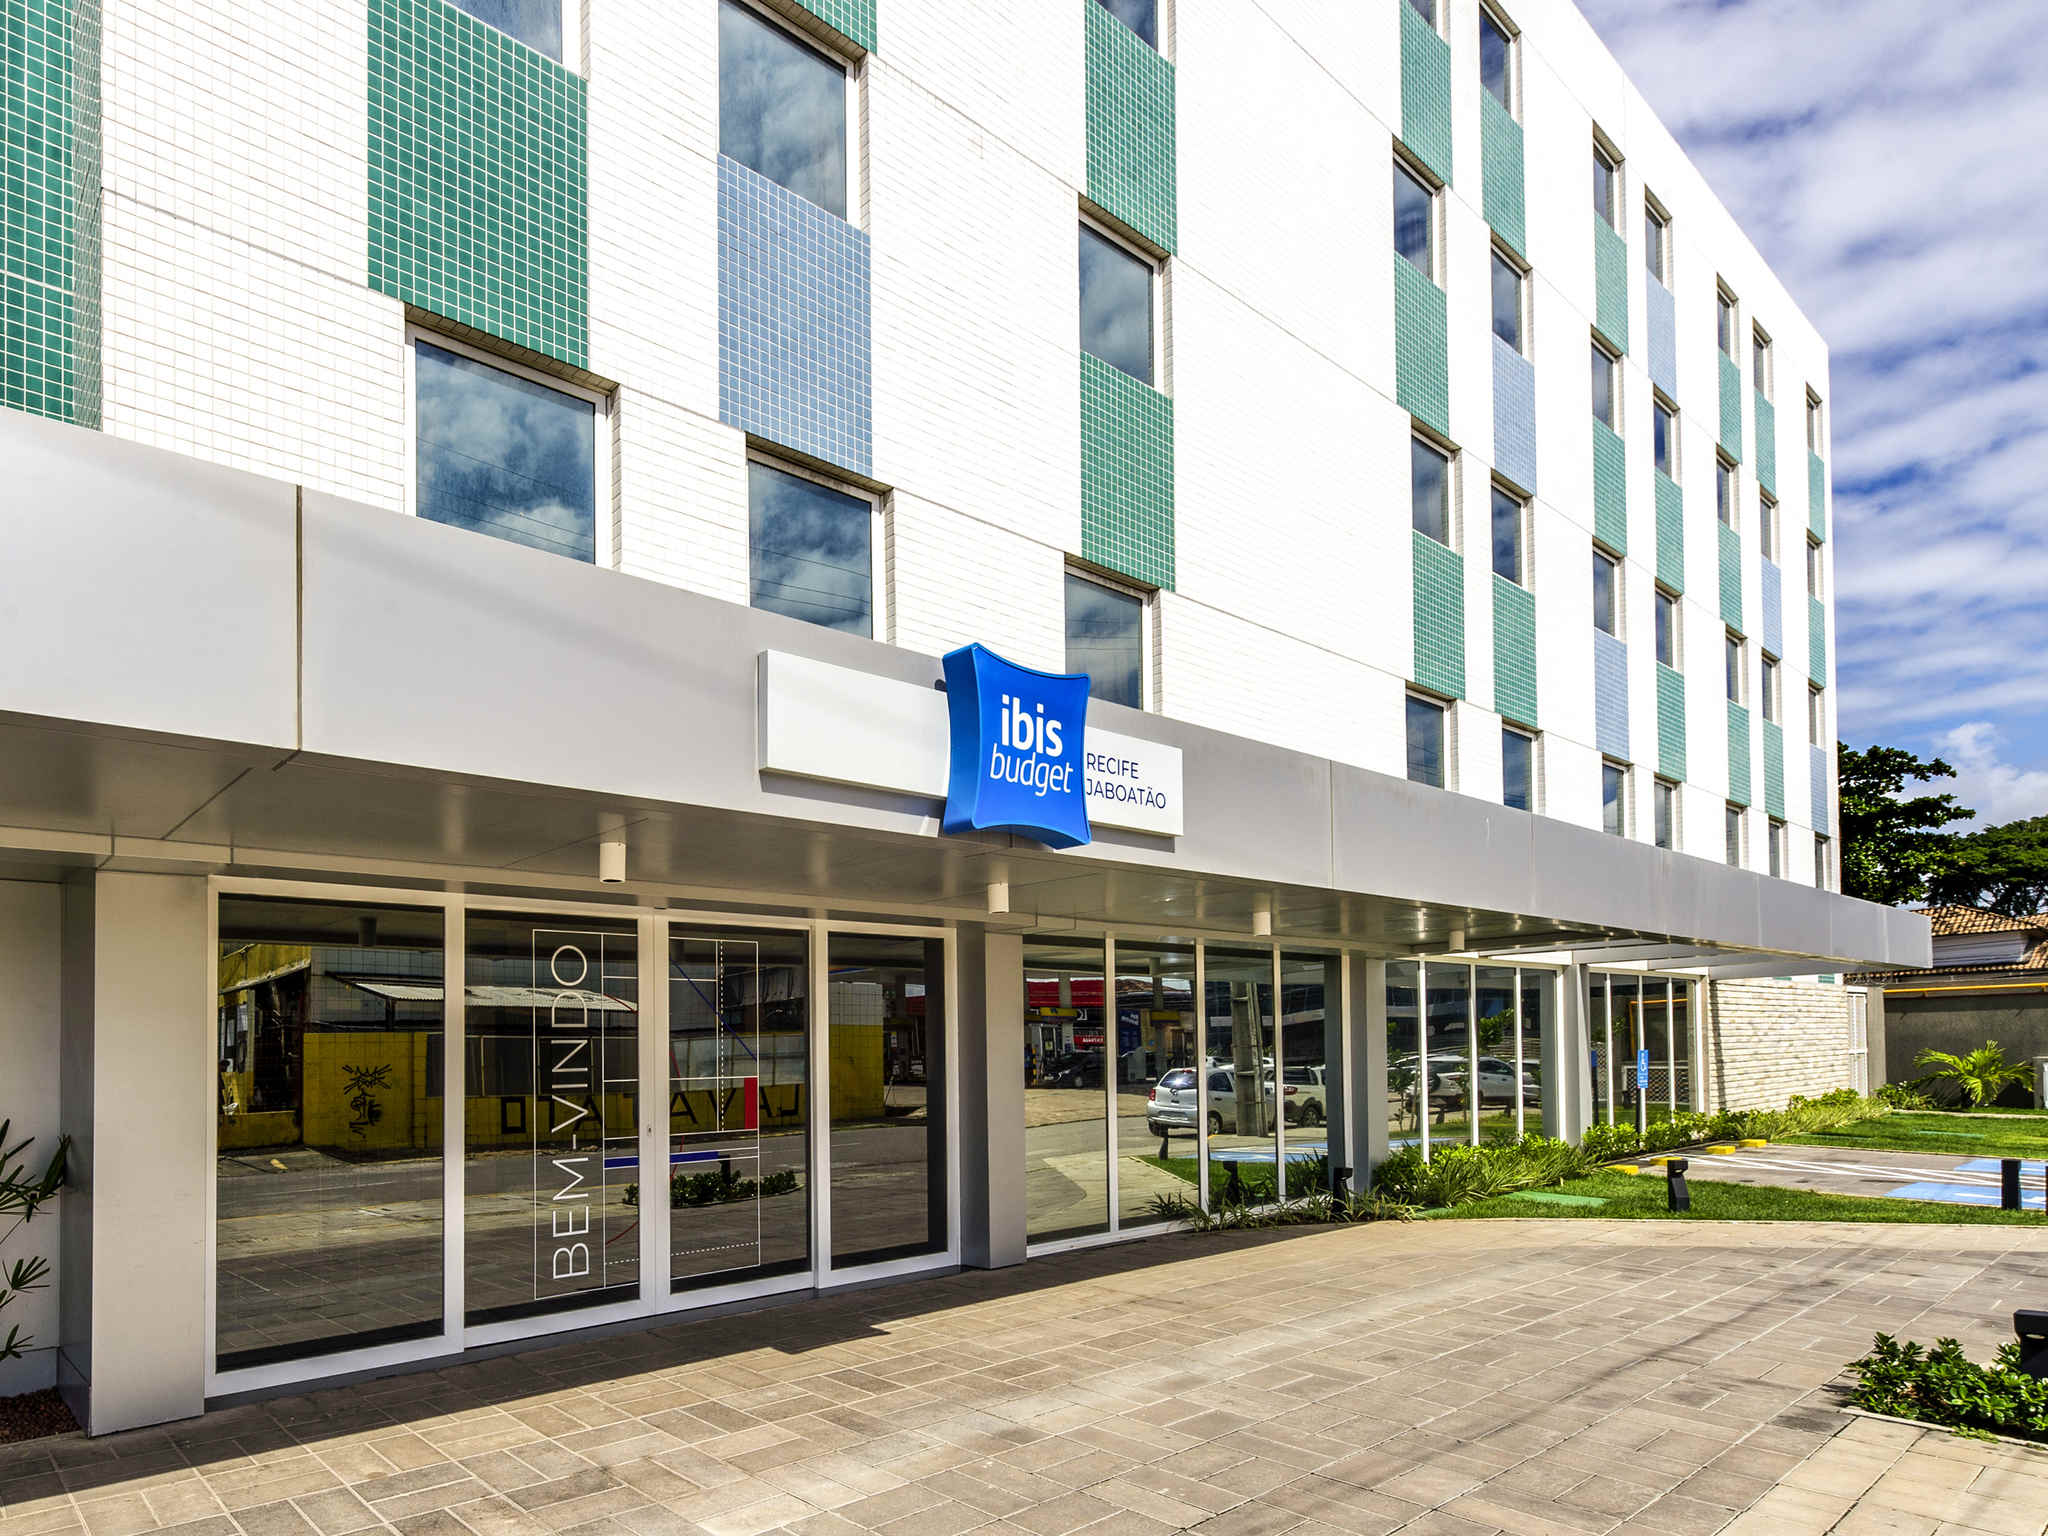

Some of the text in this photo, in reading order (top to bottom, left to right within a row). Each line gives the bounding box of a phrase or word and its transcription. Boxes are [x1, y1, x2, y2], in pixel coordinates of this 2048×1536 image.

[1001, 693, 1064, 757] ibis
[989, 742, 1074, 797] budget
[1086, 752, 1139, 779] RECIFE
[1086, 778, 1167, 809] JABOATÃO
[551, 944, 589, 1279] BEM-VINDO
